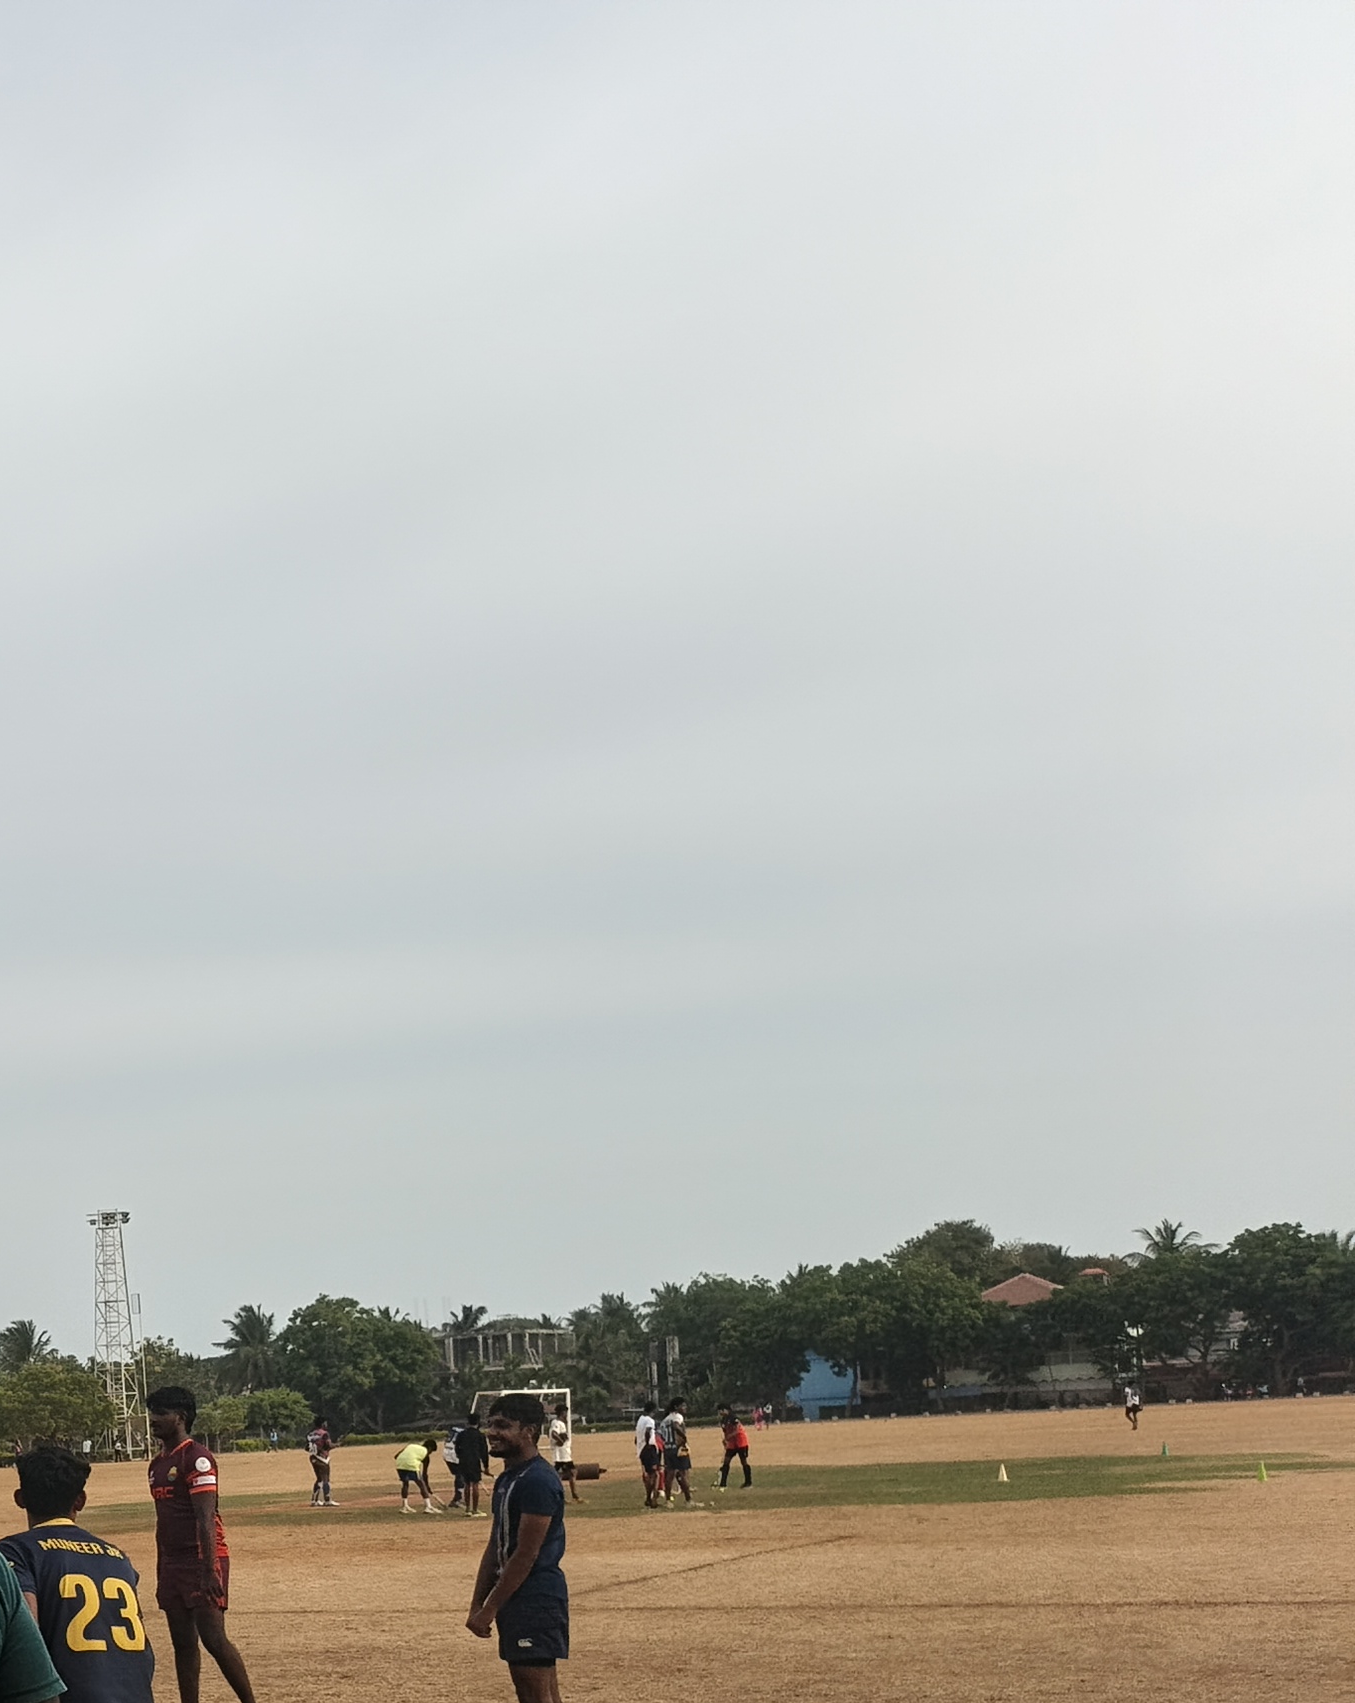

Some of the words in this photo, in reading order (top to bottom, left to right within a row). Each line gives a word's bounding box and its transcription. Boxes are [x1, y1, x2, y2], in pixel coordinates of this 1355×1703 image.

[151, 1486, 174, 1499] RC
[37, 1538, 104, 1555] MUNEER
[58, 1573, 145, 1652] 23
